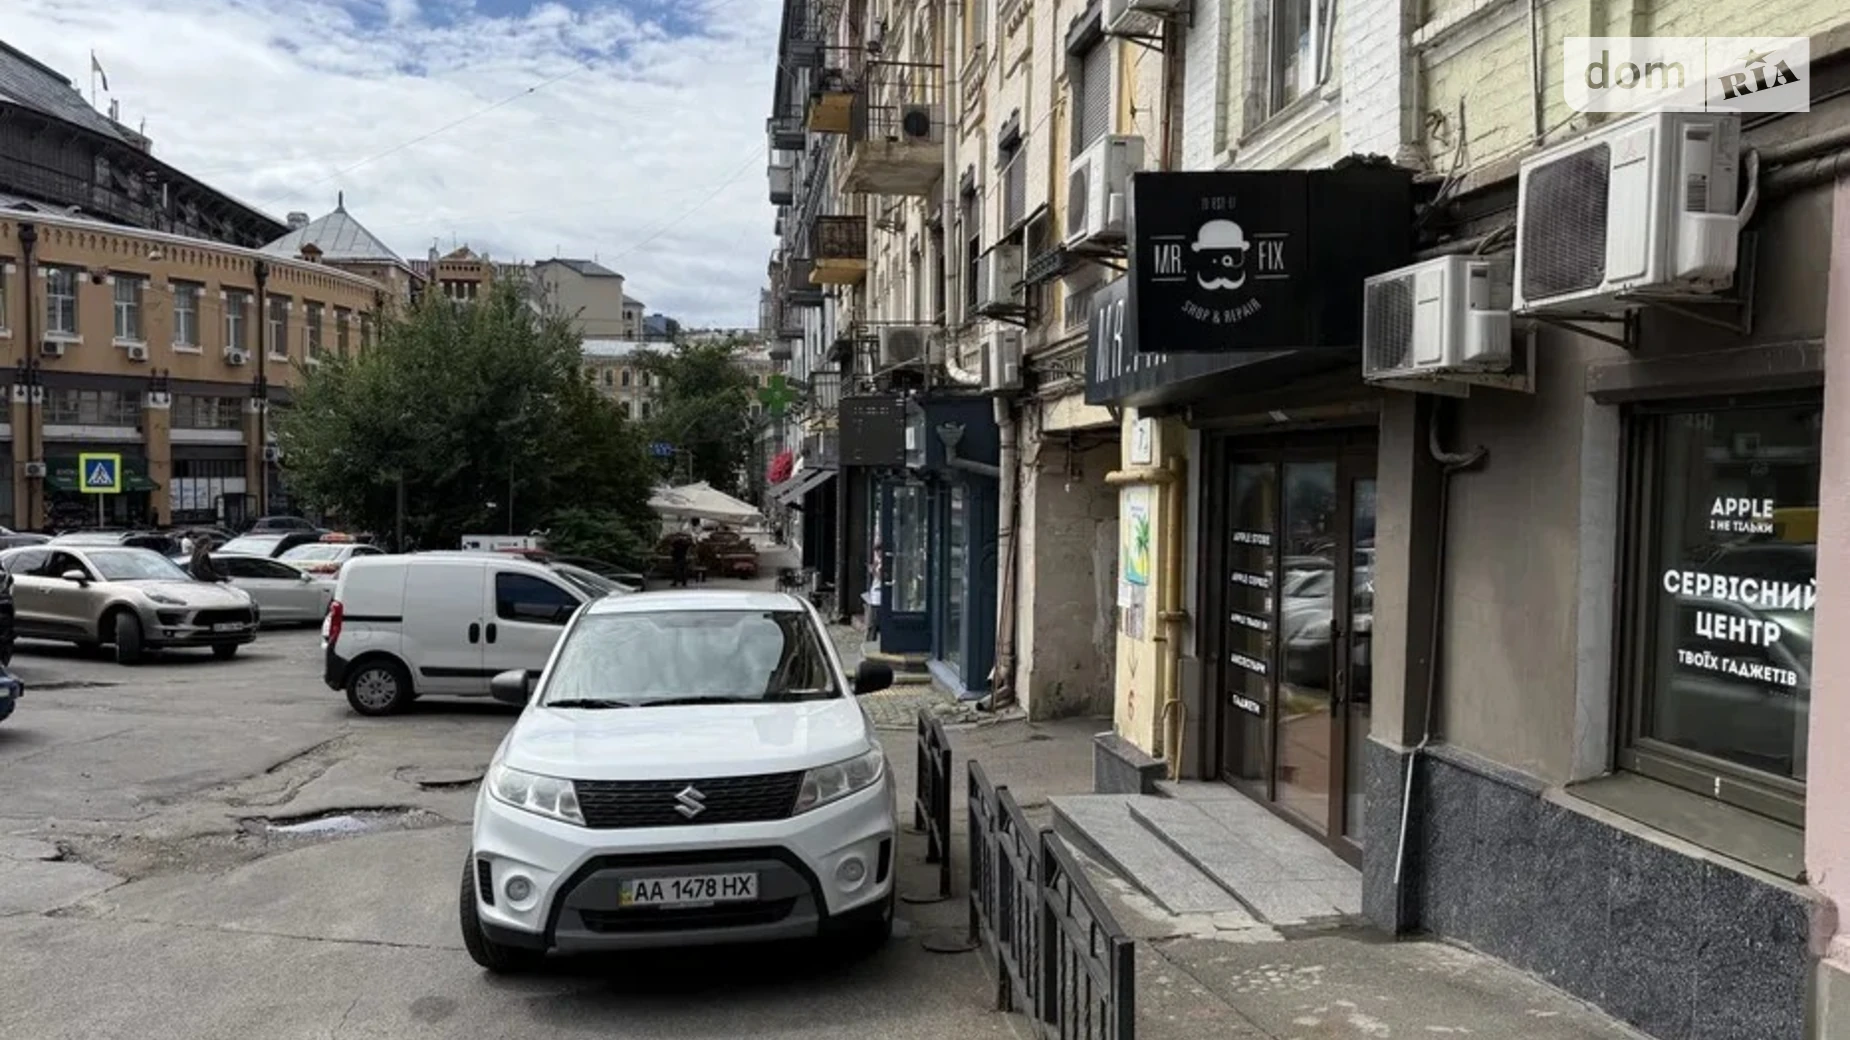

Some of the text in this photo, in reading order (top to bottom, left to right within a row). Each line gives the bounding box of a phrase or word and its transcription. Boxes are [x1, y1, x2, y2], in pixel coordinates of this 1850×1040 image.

[1154, 240, 1285, 274] MR. FIX
[1181, 298, 1262, 324] SHOP & REPAIR
[1711, 497, 1774, 518] APPLE
[1717, 520, 1730, 532] НЕ
[1733, 520, 1774, 535] ТІЛЬКИ
[1663, 569, 1818, 611] СЕРВІСНИЙ
[1695, 611, 1781, 646] ЦЕНТР
[1677, 649, 1798, 686] ТВОЇХ ГАДЖЕТІВ
[634, 875, 752, 901] AA 1478 HX
